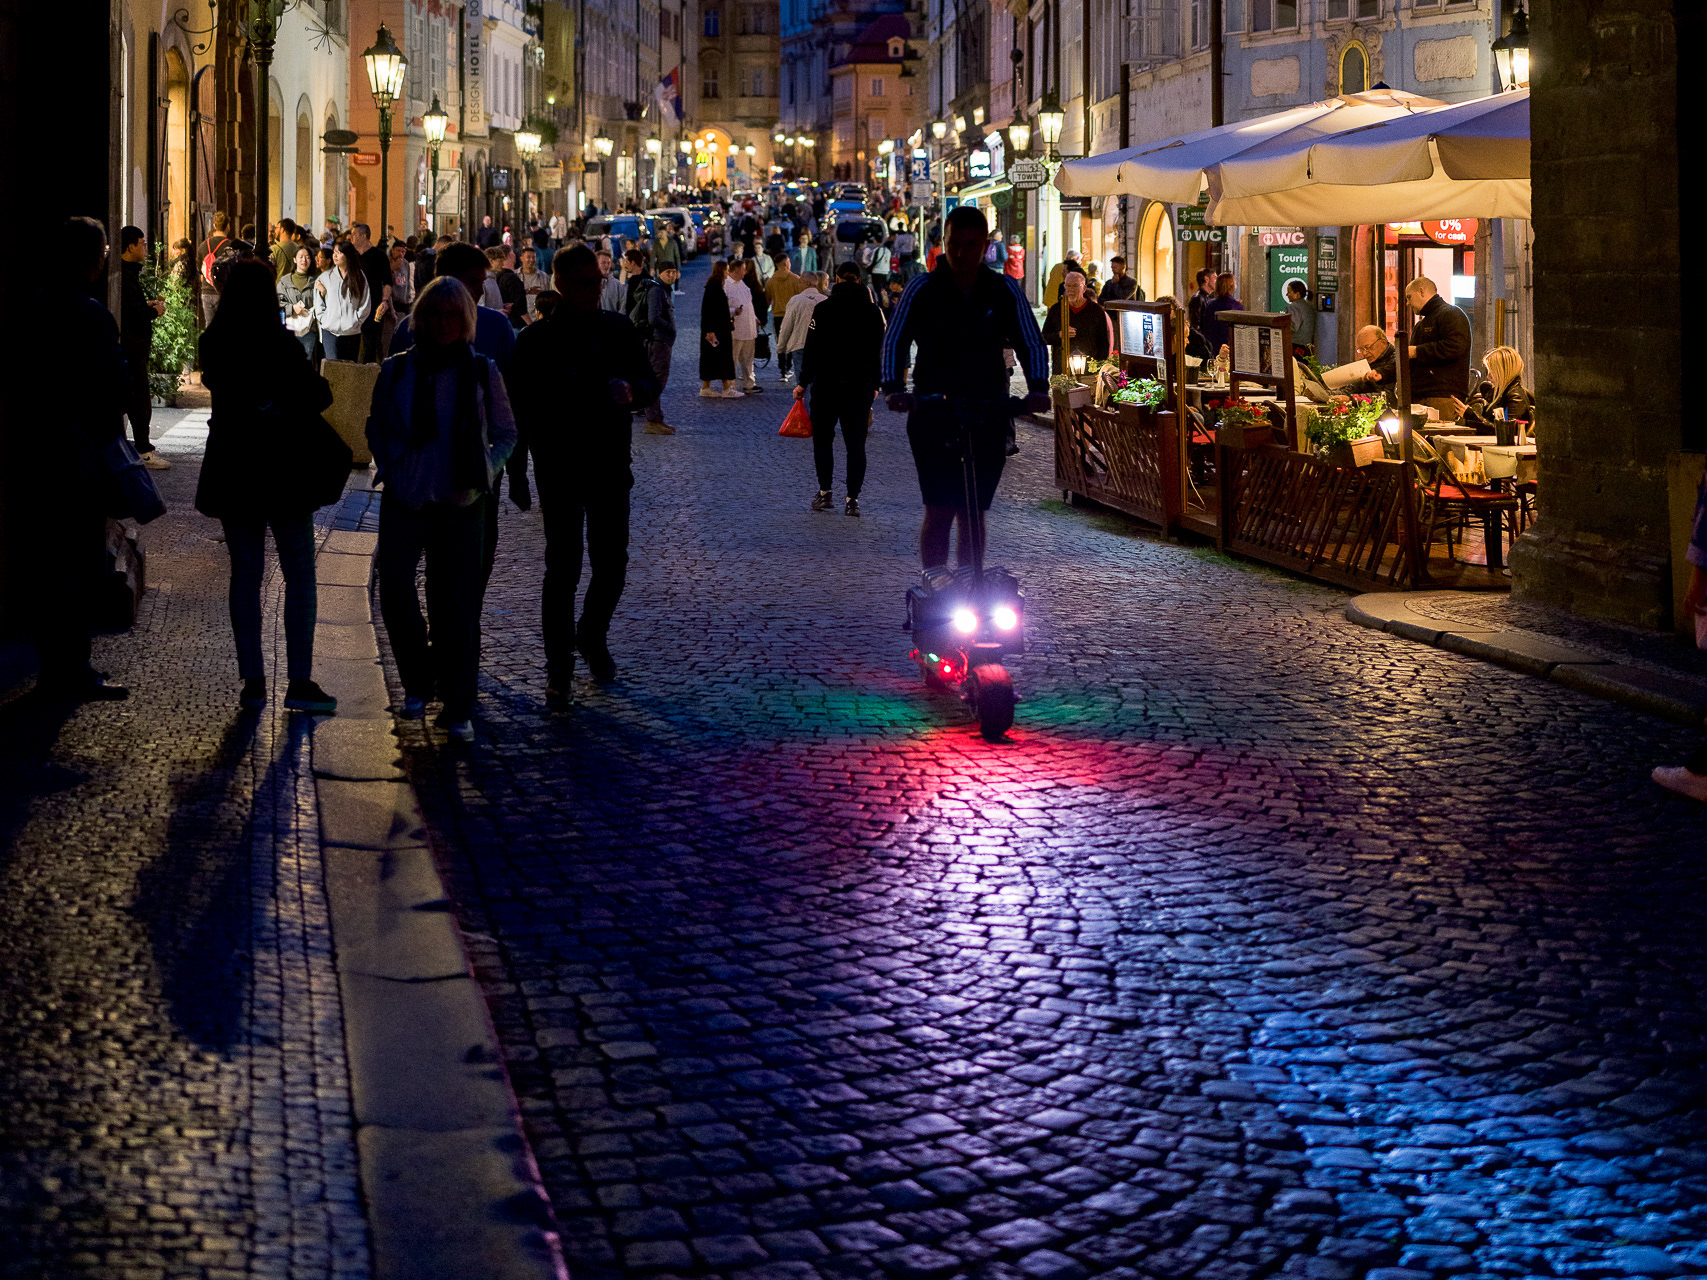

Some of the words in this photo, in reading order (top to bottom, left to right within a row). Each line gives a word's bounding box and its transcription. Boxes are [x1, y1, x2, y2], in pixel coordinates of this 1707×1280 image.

[471, 35, 479, 76] HOTEL
[471, 80, 479, 123] DESIGN
[1439, 219, 1462, 231] 0%
[1194, 230, 1222, 241] WC
[1275, 231, 1305, 245] WC
[1435, 231, 1446, 239] for
[1447, 231, 1467, 240] cash
[1317, 260, 1337, 269] HOSTEL
